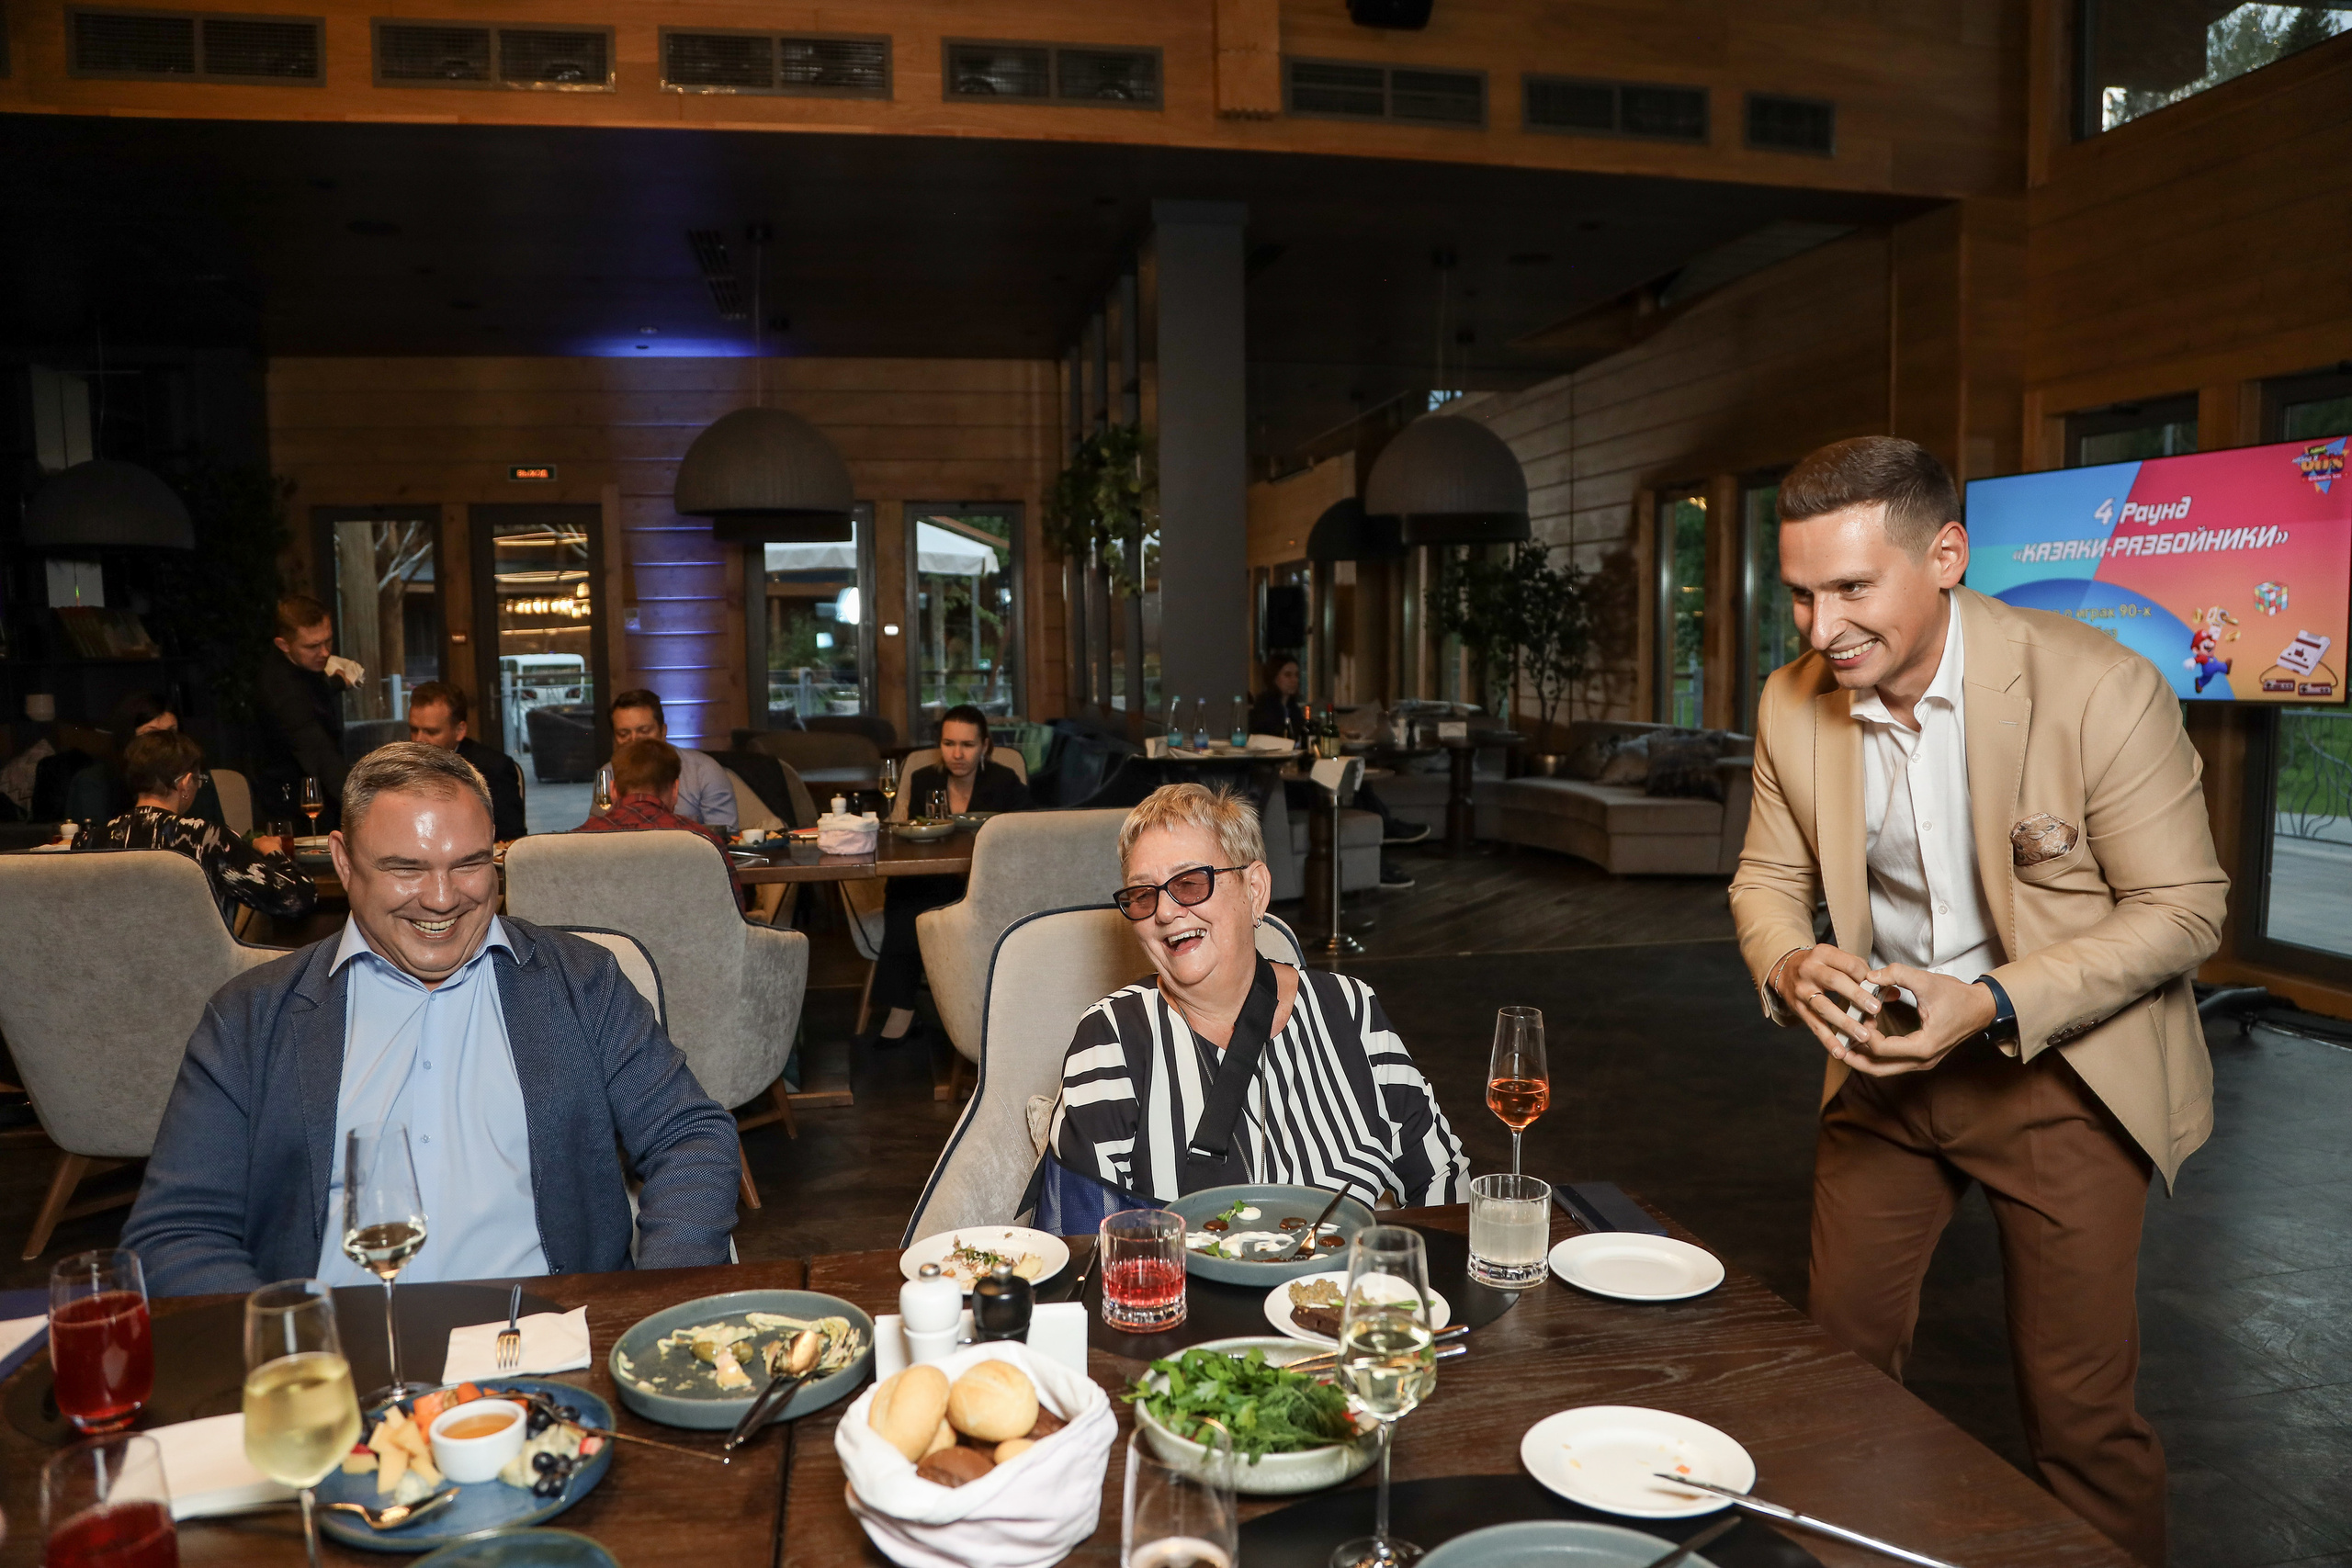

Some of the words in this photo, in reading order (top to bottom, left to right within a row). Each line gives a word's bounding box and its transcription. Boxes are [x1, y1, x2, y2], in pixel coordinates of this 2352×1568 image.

[516, 468, 548, 478] ВЫХОД
[2094, 497, 2114, 525] 4
[2120, 495, 2192, 526] Раунд
[2012, 525, 2290, 563] «КАЗАКИ-РАЗБОЙНИКИ»
[2075, 606, 2115, 622] играх
[2119, 604, 2152, 618] 90-х
